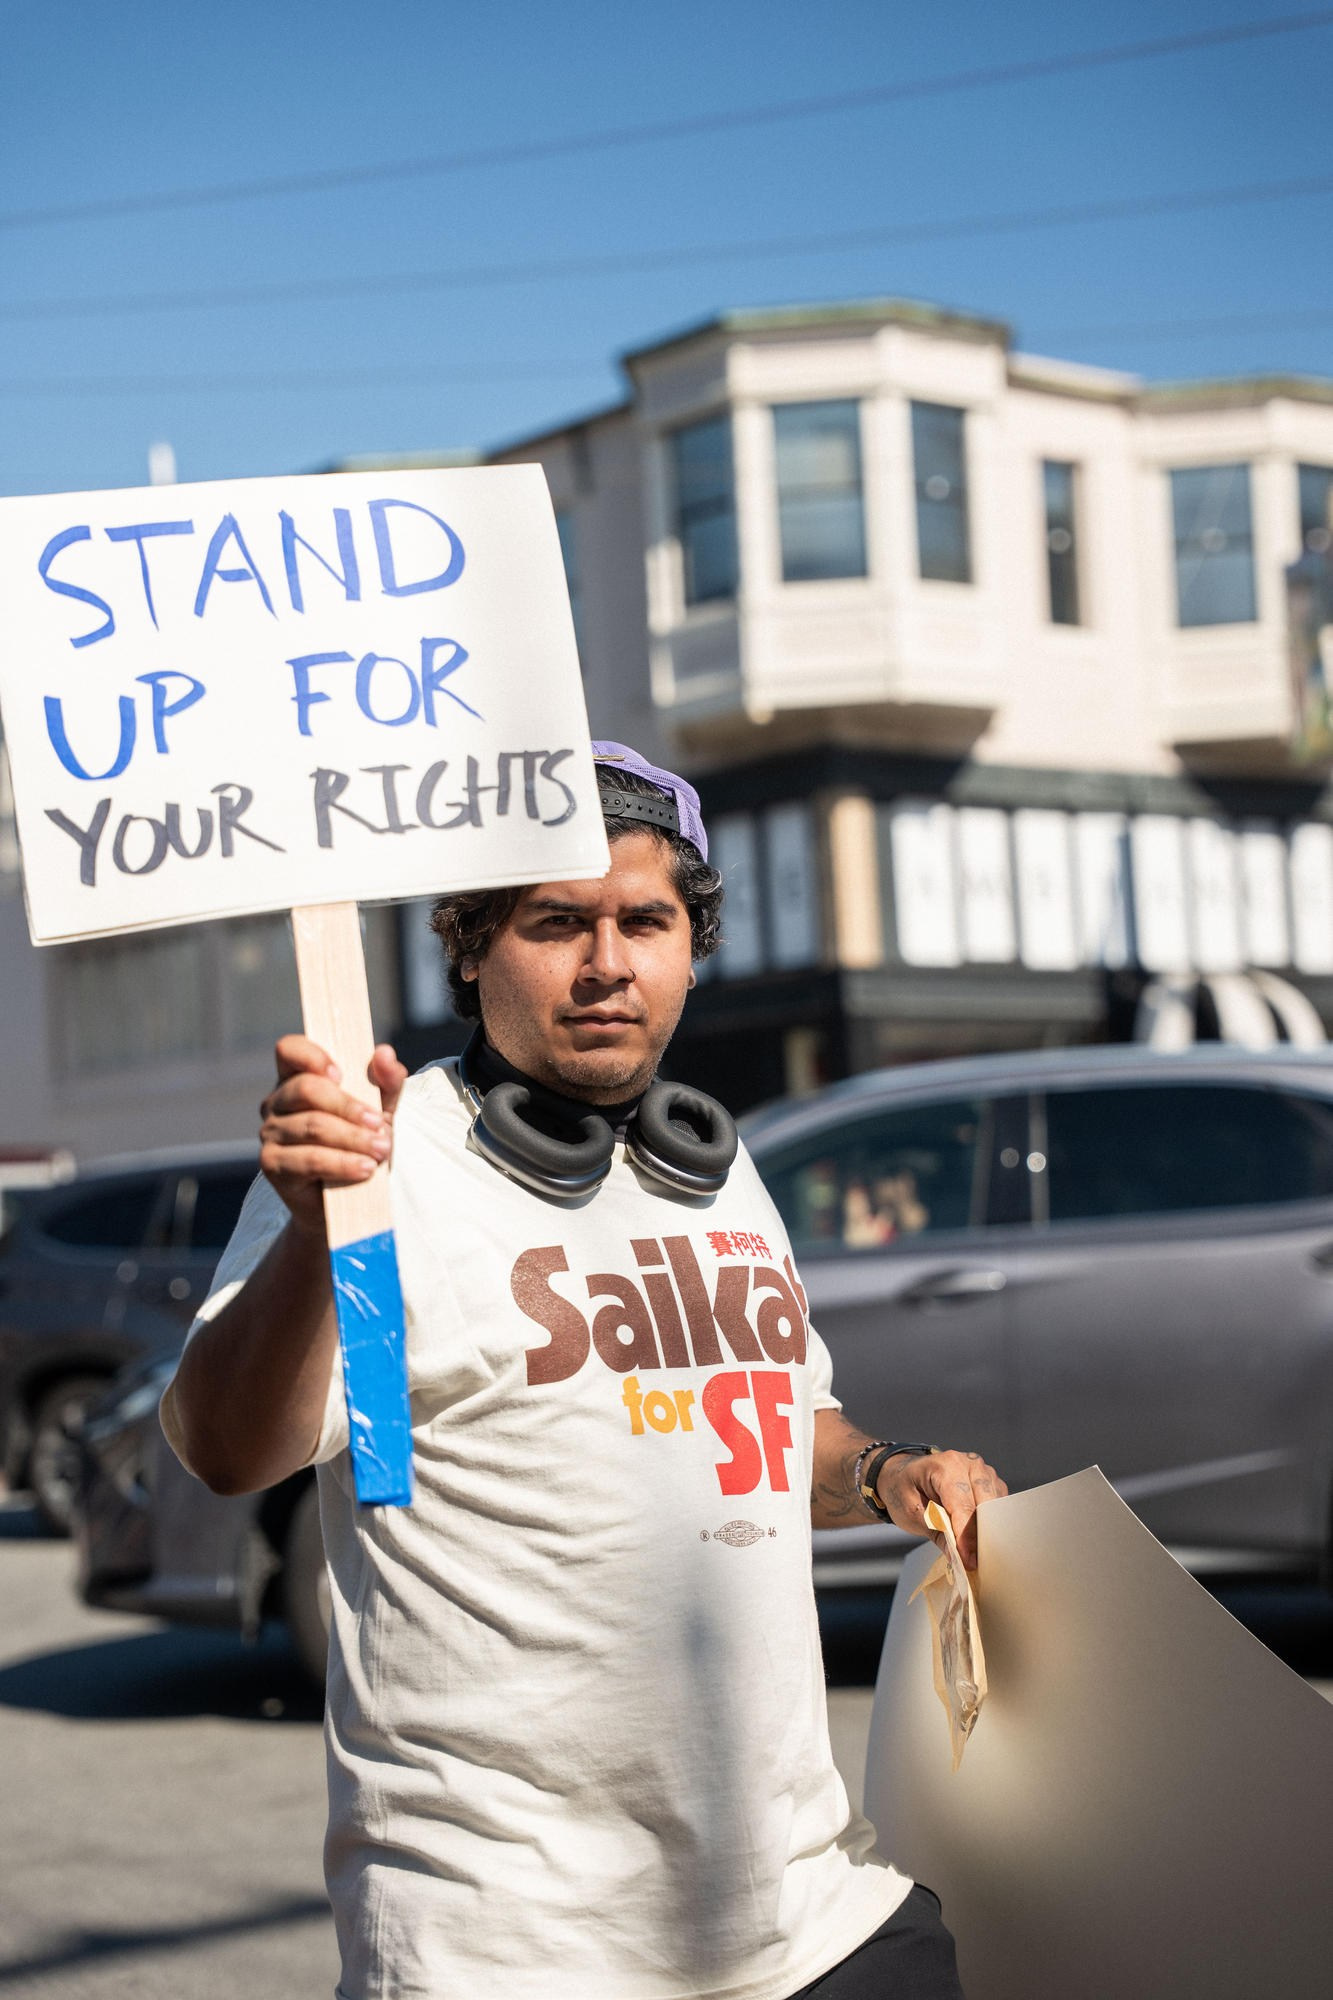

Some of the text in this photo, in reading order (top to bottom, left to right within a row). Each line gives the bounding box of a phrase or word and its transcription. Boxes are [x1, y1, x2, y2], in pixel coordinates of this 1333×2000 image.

[38, 498, 466, 648] STAND
[43, 637, 486, 780] UP FOR
[44, 749, 577, 887] YOUR RIGHTS
[622, 1371, 794, 1496] for SF
[767, 1527, 777, 1538] 46
